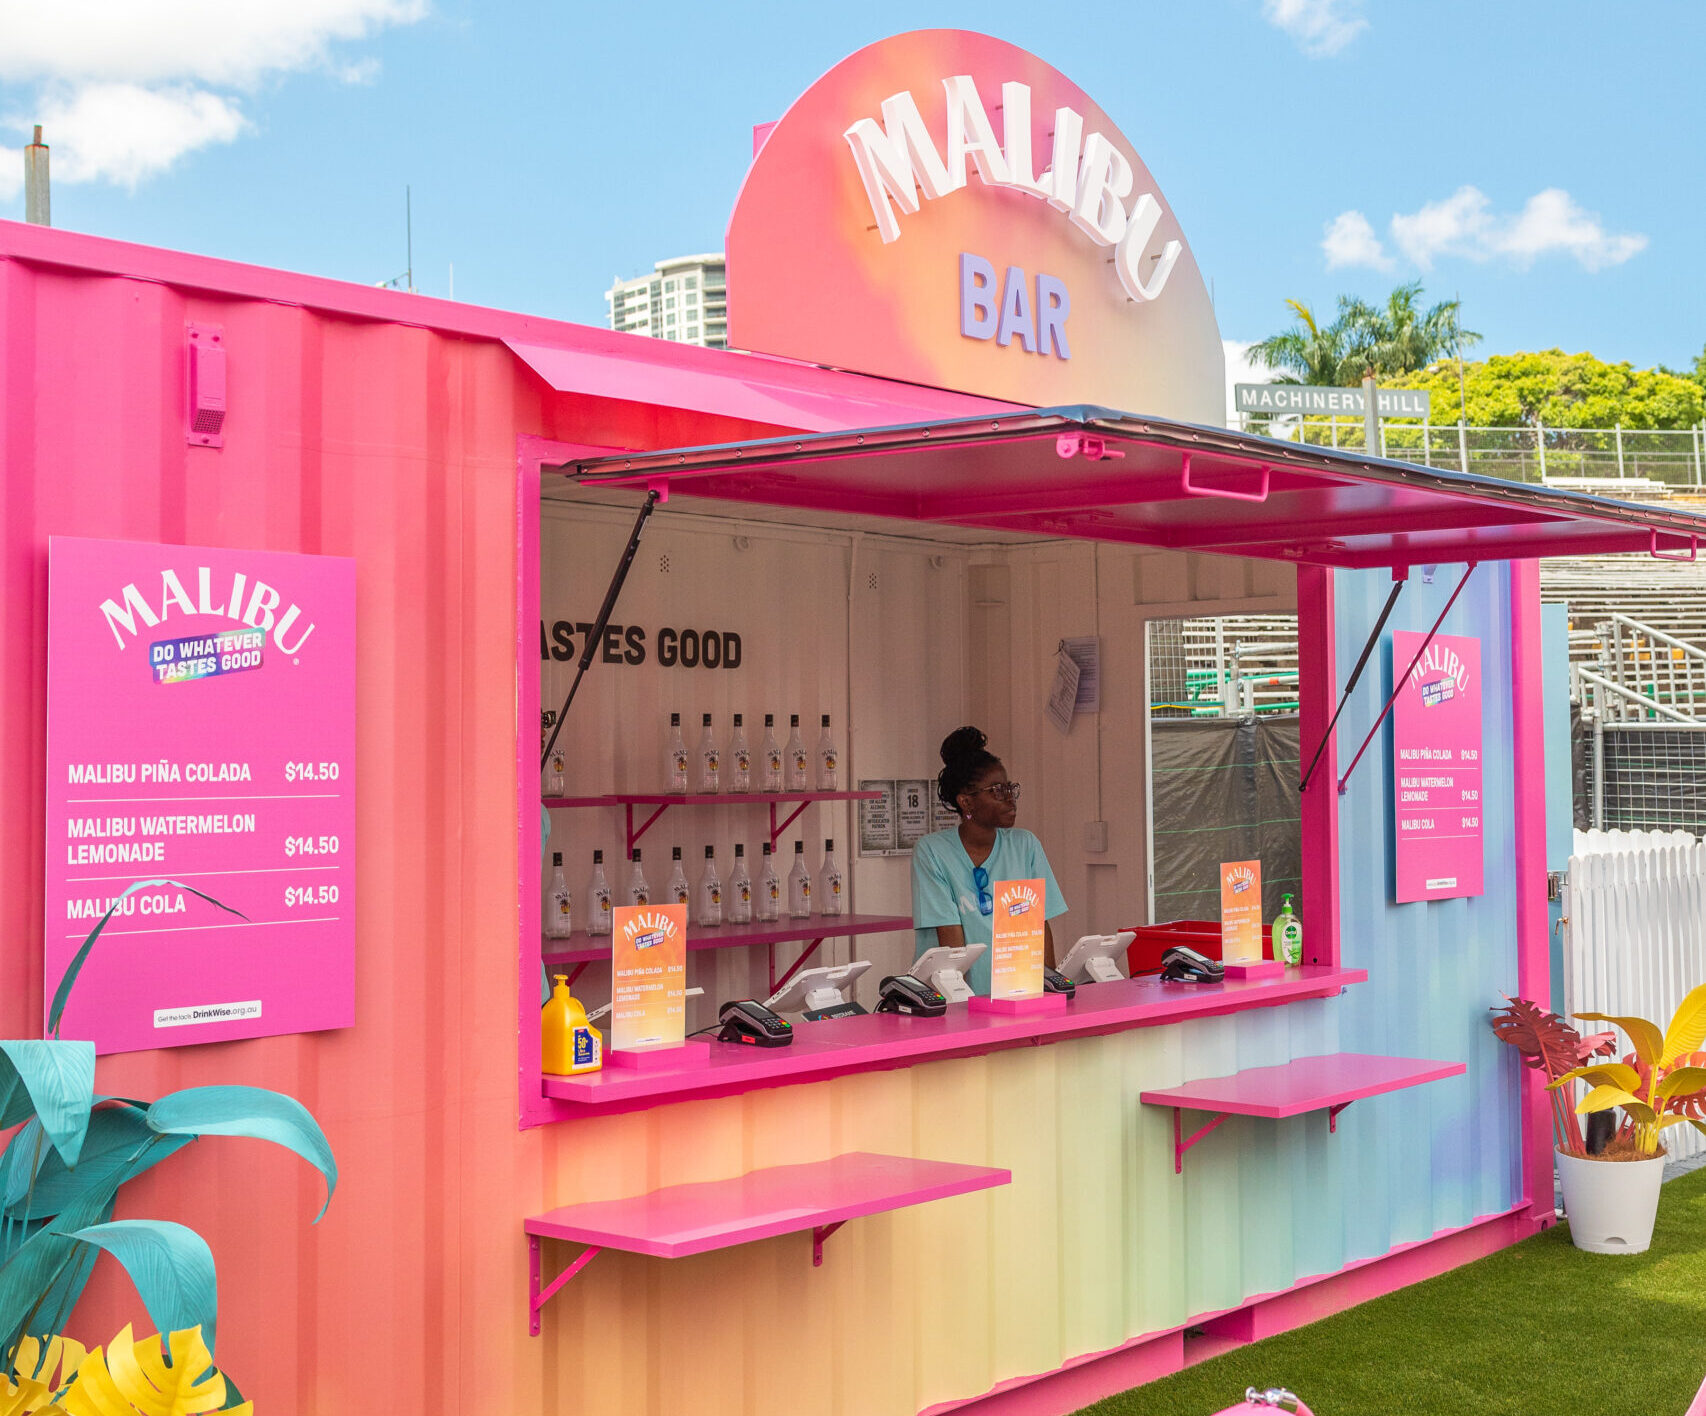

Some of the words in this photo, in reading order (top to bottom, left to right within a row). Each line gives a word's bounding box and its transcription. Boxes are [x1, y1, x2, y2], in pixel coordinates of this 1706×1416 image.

[843, 75, 1182, 302] MALIBU
[959, 252, 1072, 360] BAR
[1241, 388, 1365, 411] MACHINERY
[1378, 393, 1425, 412] HILL
[99, 567, 315, 655] MALIBU
[153, 644, 174, 662] DO
[179, 632, 262, 659] WHATEVER
[541, 620, 646, 666] STES
[657, 627, 742, 669] GOOD
[156, 658, 216, 680] TASTES
[221, 651, 260, 670] GOOD
[1407, 644, 1470, 692] MALIBU
[68, 763, 136, 784] MALIBU
[141, 759, 181, 783] PIÑA
[185, 763, 251, 782] COLADA
[285, 761, 339, 782] $14.50
[907, 794, 919, 808] 18
[68, 817, 135, 838] MALIBU
[140, 814, 255, 836] WATERMELON
[67, 842, 164, 865] LEMONADE
[285, 836, 339, 857] $14.50
[67, 897, 135, 919] MALIBU
[140, 894, 186, 915] COLA
[285, 885, 339, 907] $14.50
[1000, 885, 1040, 909] MALIBU
[623, 912, 678, 942] MALIBU
[193, 1006, 257, 1019] DrinkWise.org.au
